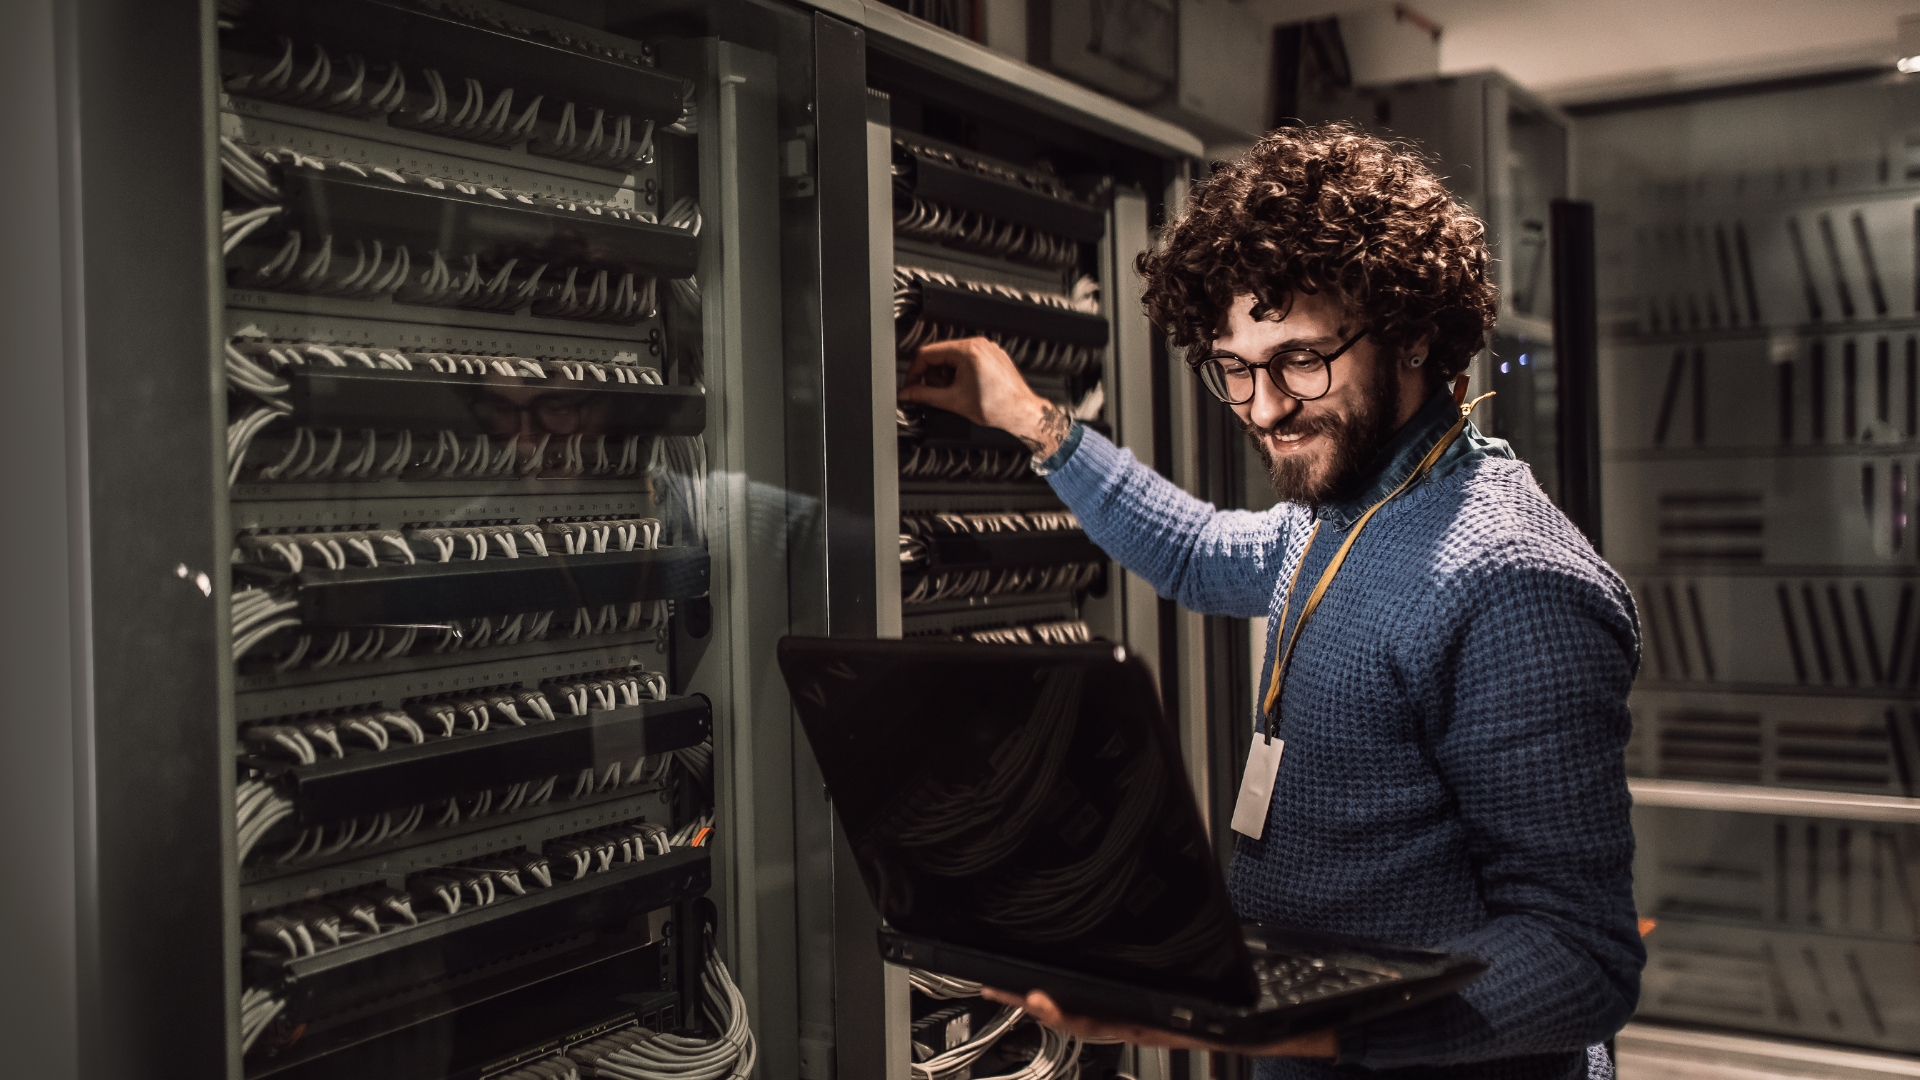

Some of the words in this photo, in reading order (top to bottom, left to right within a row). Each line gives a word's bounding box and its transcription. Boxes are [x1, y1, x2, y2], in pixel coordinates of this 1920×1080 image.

[395, 157, 401, 165] 9
[410, 159, 419, 167] 10
[426, 162, 434, 170] 11
[441, 165, 450, 173] 12
[457, 168, 465, 176] 13
[486, 173, 495, 181] 15
[545, 184, 553, 192] 18
[558, 186, 566, 194] 19
[398, 334, 405, 342] 9
[413, 335, 422, 343] 10
[430, 336, 438, 344] 11
[504, 342, 513, 350] 16
[534, 343, 542, 351] 17
[600, 348, 609, 356] 22
[402, 509, 408, 517] 9
[417, 509, 425, 517] 10
[448, 508, 457, 516] 12
[464, 507, 472, 515] 13
[537, 505, 545, 513] 17
[565, 504, 573, 512] 19
[405, 684, 412, 692] 9
[421, 682, 429, 690] 10
[437, 680, 445, 688] 11
[452, 678, 461, 686] 12
[467, 676, 476, 684] 13
[471, 844, 479, 852] 13
[571, 820, 579, 828] 19
[584, 817, 593, 825] 20
[622, 807, 630, 815] 23
